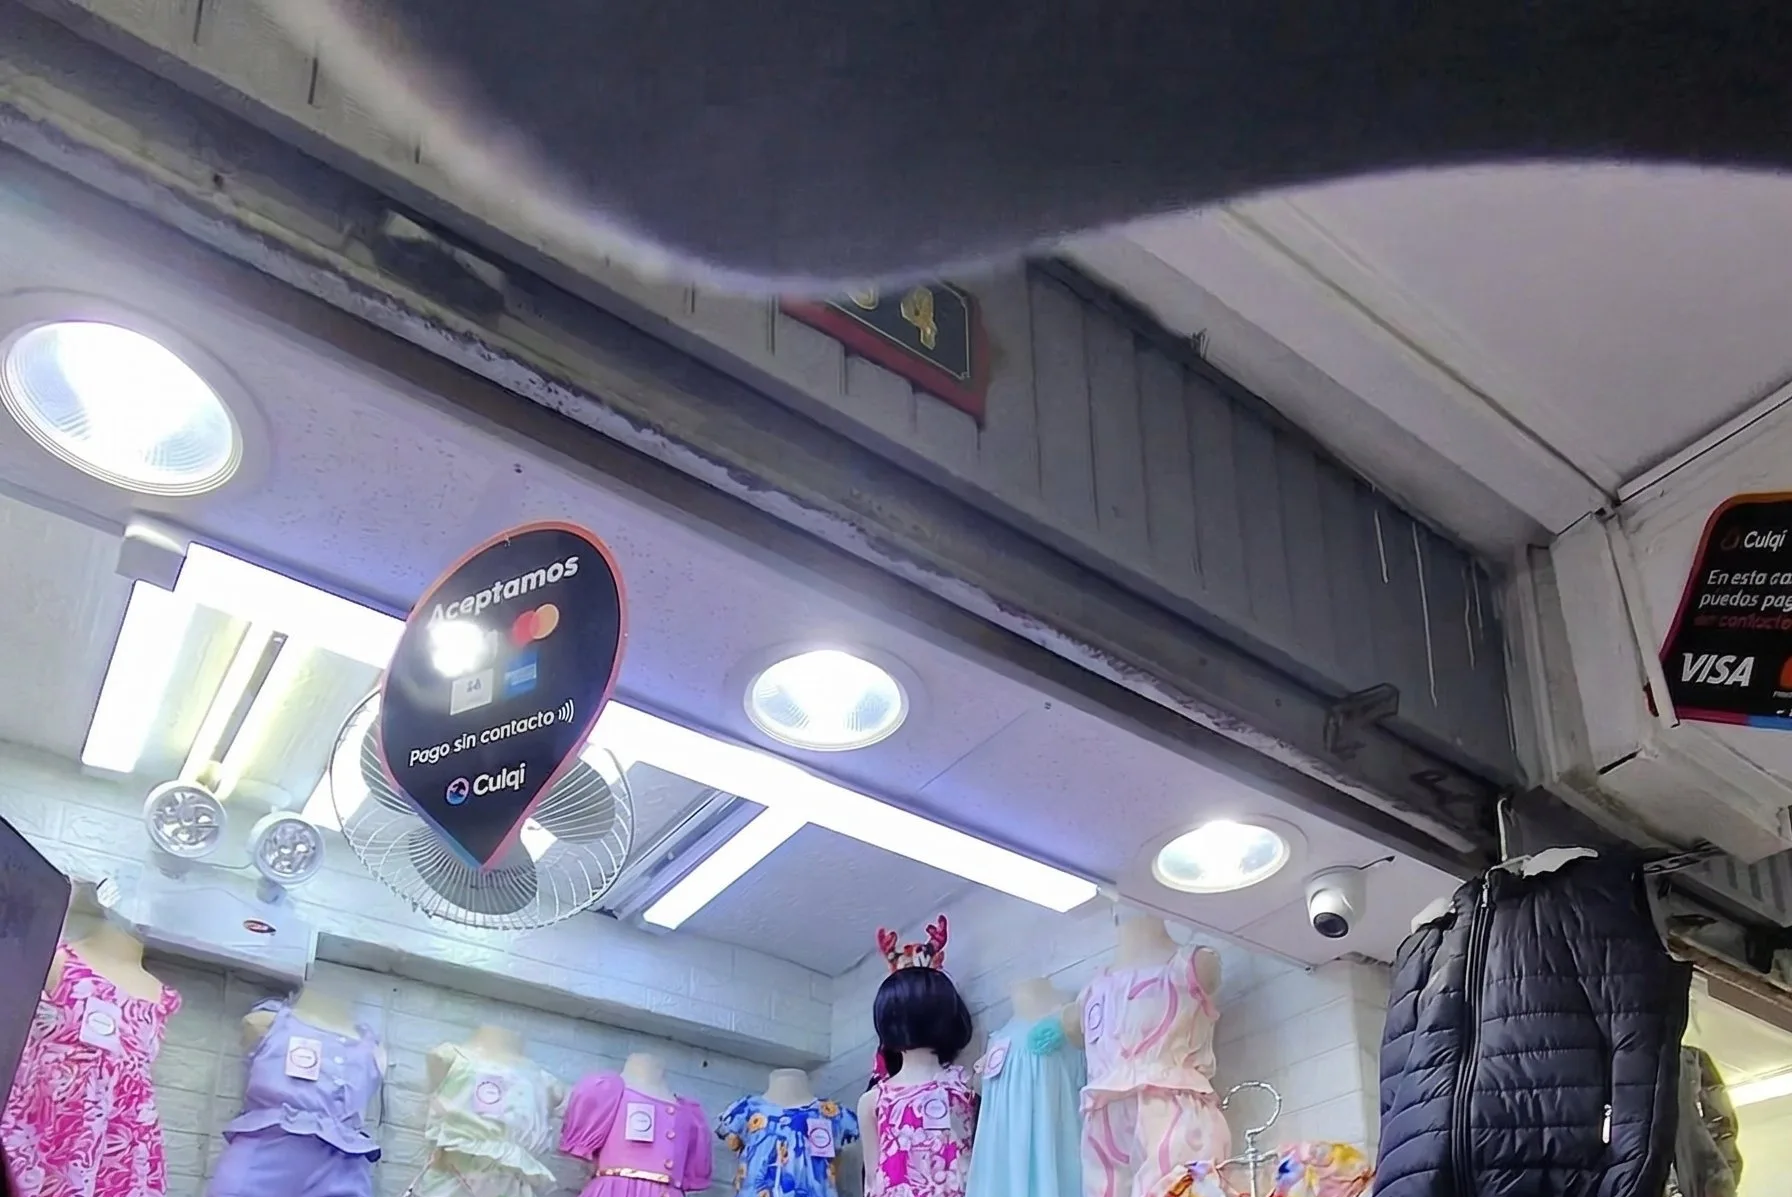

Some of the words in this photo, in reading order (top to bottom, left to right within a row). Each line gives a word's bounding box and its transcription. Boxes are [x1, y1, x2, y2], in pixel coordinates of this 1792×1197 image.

[1744, 529, 1788, 552] Culqi
[426, 556, 579, 628] Aceptamos
[1707, 569, 1729, 585] En
[1730, 570, 1768, 585] esta
[1769, 571, 1792, 586] ca
[1681, 652, 1755, 687] VISA
[409, 743, 450, 767] Pago
[453, 733, 476, 752] sin
[480, 710, 555, 744] contacto
[473, 762, 526, 796] Culqi
